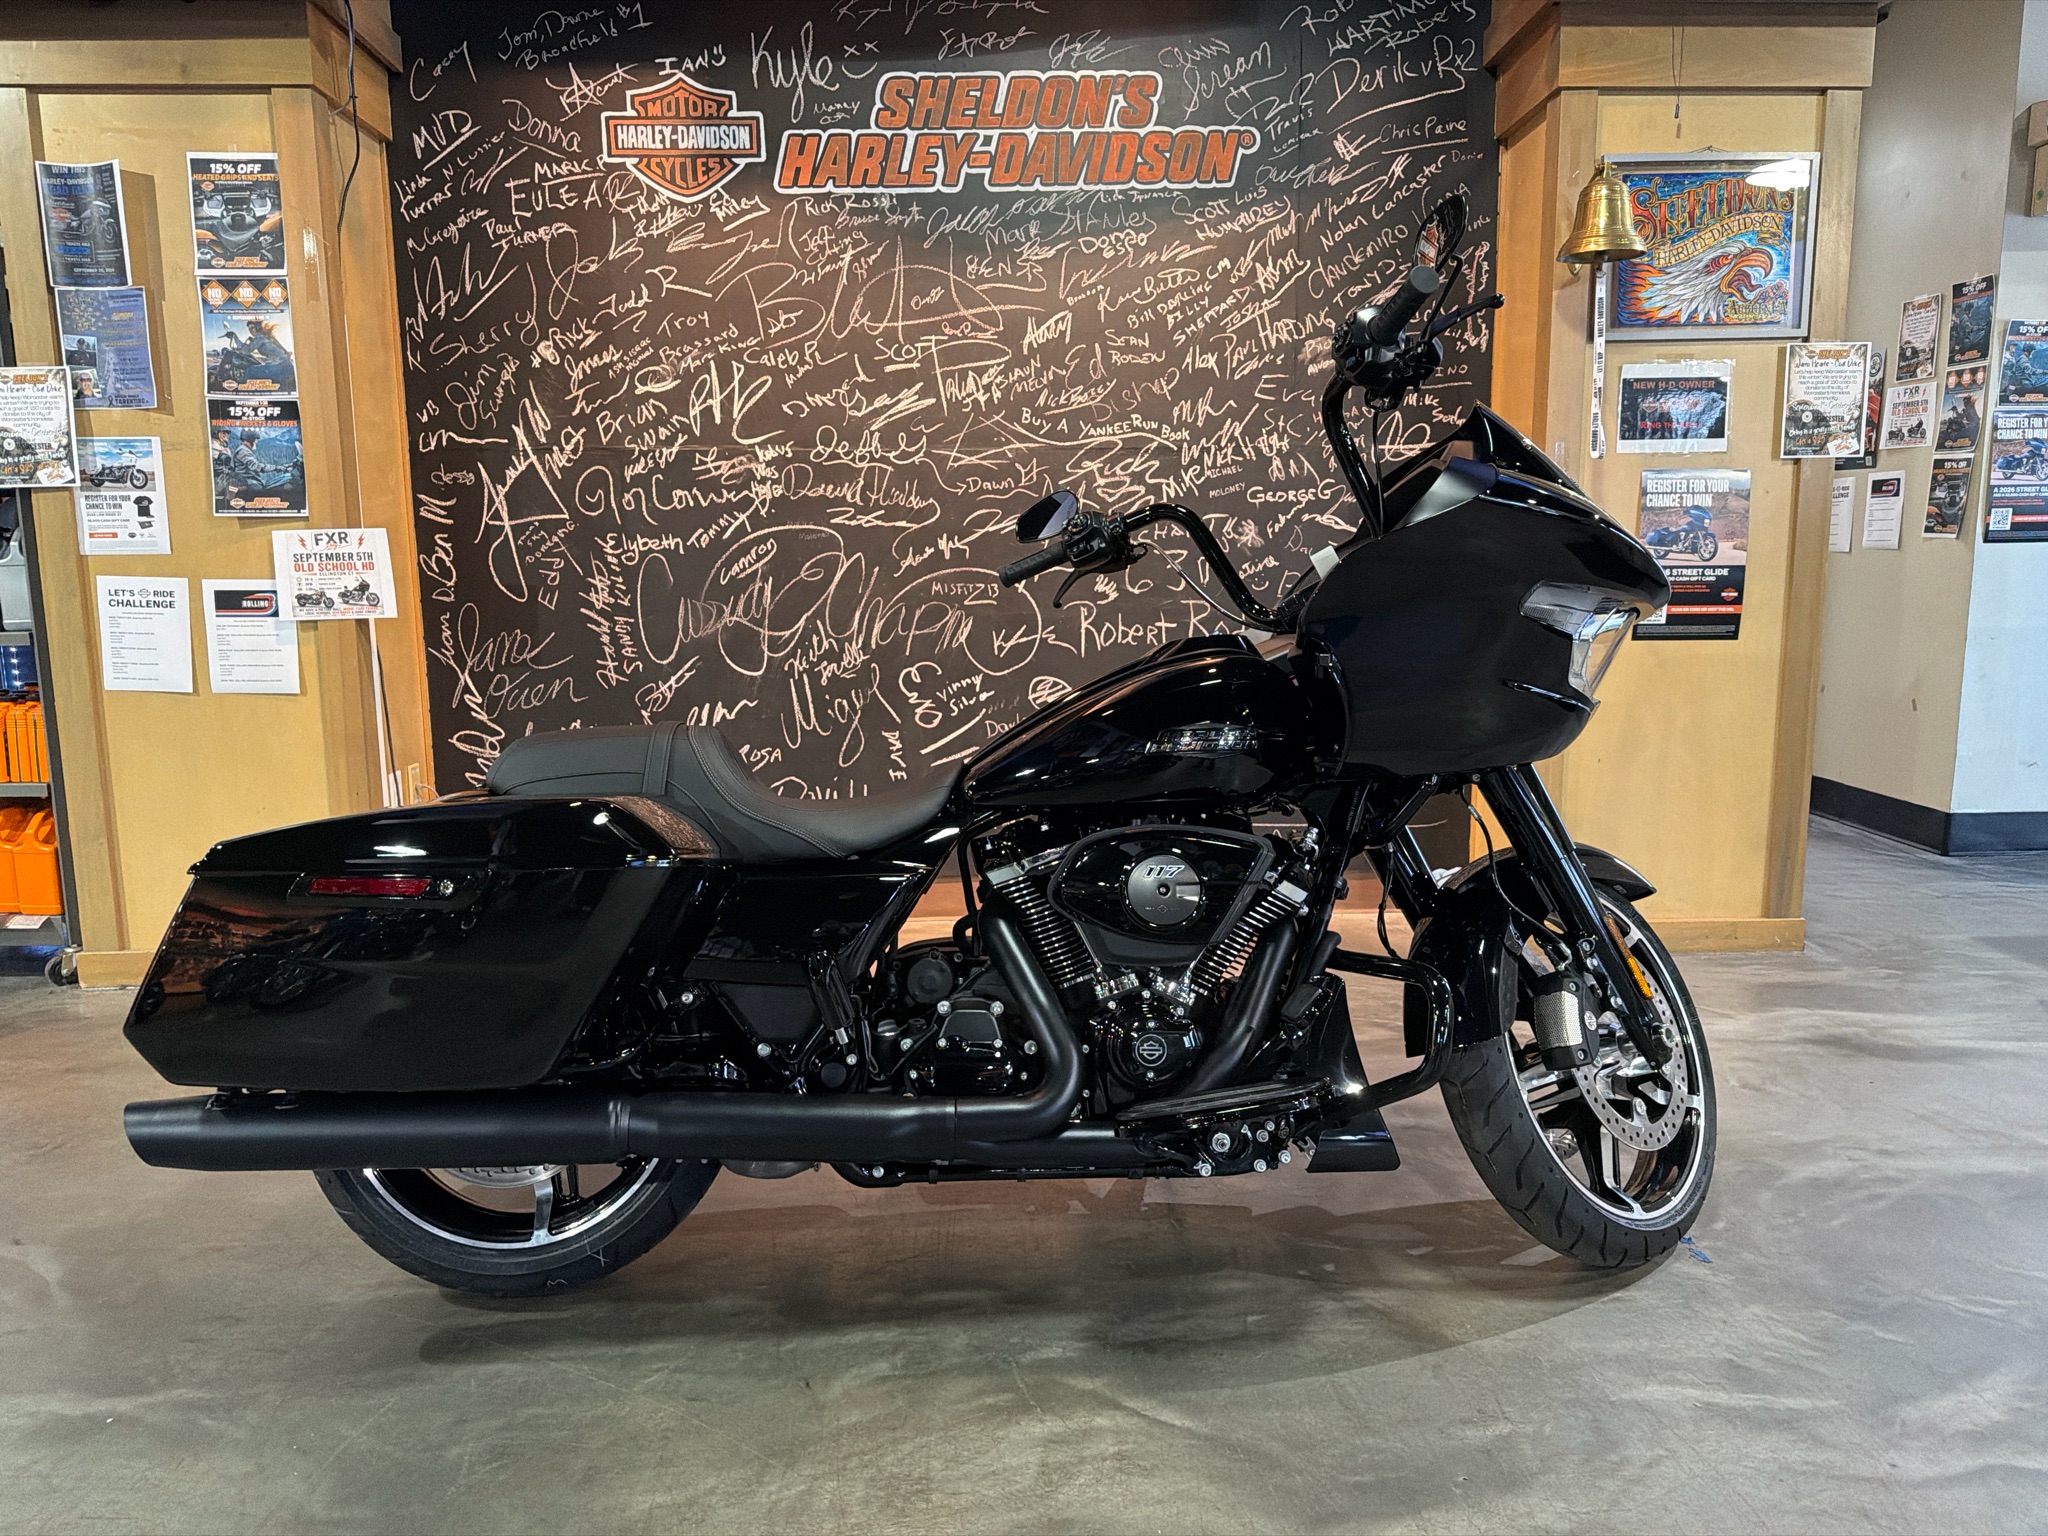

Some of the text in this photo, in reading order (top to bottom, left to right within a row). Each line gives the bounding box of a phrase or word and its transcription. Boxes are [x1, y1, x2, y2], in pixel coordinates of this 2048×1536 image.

[751, 21, 840, 124] Kyle
[647, 88, 718, 118] MOTOR
[877, 75, 1157, 128] SHELDON'S
[502, 99, 582, 153] Donna
[616, 125, 751, 149] HARLEY-DAVIDSON
[1379, 123, 1421, 143] Chris
[51, 165, 86, 174] WIN THIS
[210, 163, 262, 174] 15% OFF
[650, 157, 721, 188] CYCLES
[193, 173, 279, 182] HEATED GRIPS AND SEATS
[1371, 154, 1447, 220] Lancaster
[1320, 214, 1369, 252] Nolan
[1655, 214, 1782, 266] HARLEY-DAVIDSON
[207, 288, 222, 298] NO
[239, 287, 253, 297] NO
[268, 287, 282, 297] NO
[1962, 282, 1987, 294] 15% OFF
[656, 310, 710, 338] Troy
[2019, 325, 2036, 334] 15%
[743, 348, 800, 369] Caleb
[1632, 380, 1716, 390] NEW H-D OWNER
[1903, 385, 1920, 398] FXR
[228, 407, 281, 416] 15% OFF
[596, 398, 668, 446] Brian
[1057, 418, 1068, 433] A
[1997, 417, 2043, 429] REGISTER FOR
[1997, 428, 2024, 439] CHANCE
[2024, 428, 2033, 439] TO
[1204, 466, 1244, 479] MICHAEL
[966, 476, 1016, 493] Dawn
[1209, 482, 1246, 498] MOLONEY
[1646, 479, 1731, 493] REGISTER FOR YOUR
[84, 494, 131, 502] REGISTER FOR YOUR
[1646, 493, 1714, 508] CHANCE TO WIN
[85, 502, 123, 510] CHANCE TO WIN
[313, 531, 350, 547] FXR
[293, 551, 374, 563] SEPTEMBER 5TH
[293, 561, 375, 573] OLD SCHOOL HD
[1672, 568, 1730, 576] STREET GLIDE
[108, 589, 176, 598] LET'S RIDE
[108, 598, 176, 609] CHALLENGE
[241, 600, 270, 608] ROLLING
[1062, 600, 1178, 659] Robert
[936, 673, 985, 703] Vinny
[1143, 864, 1186, 879] 117
